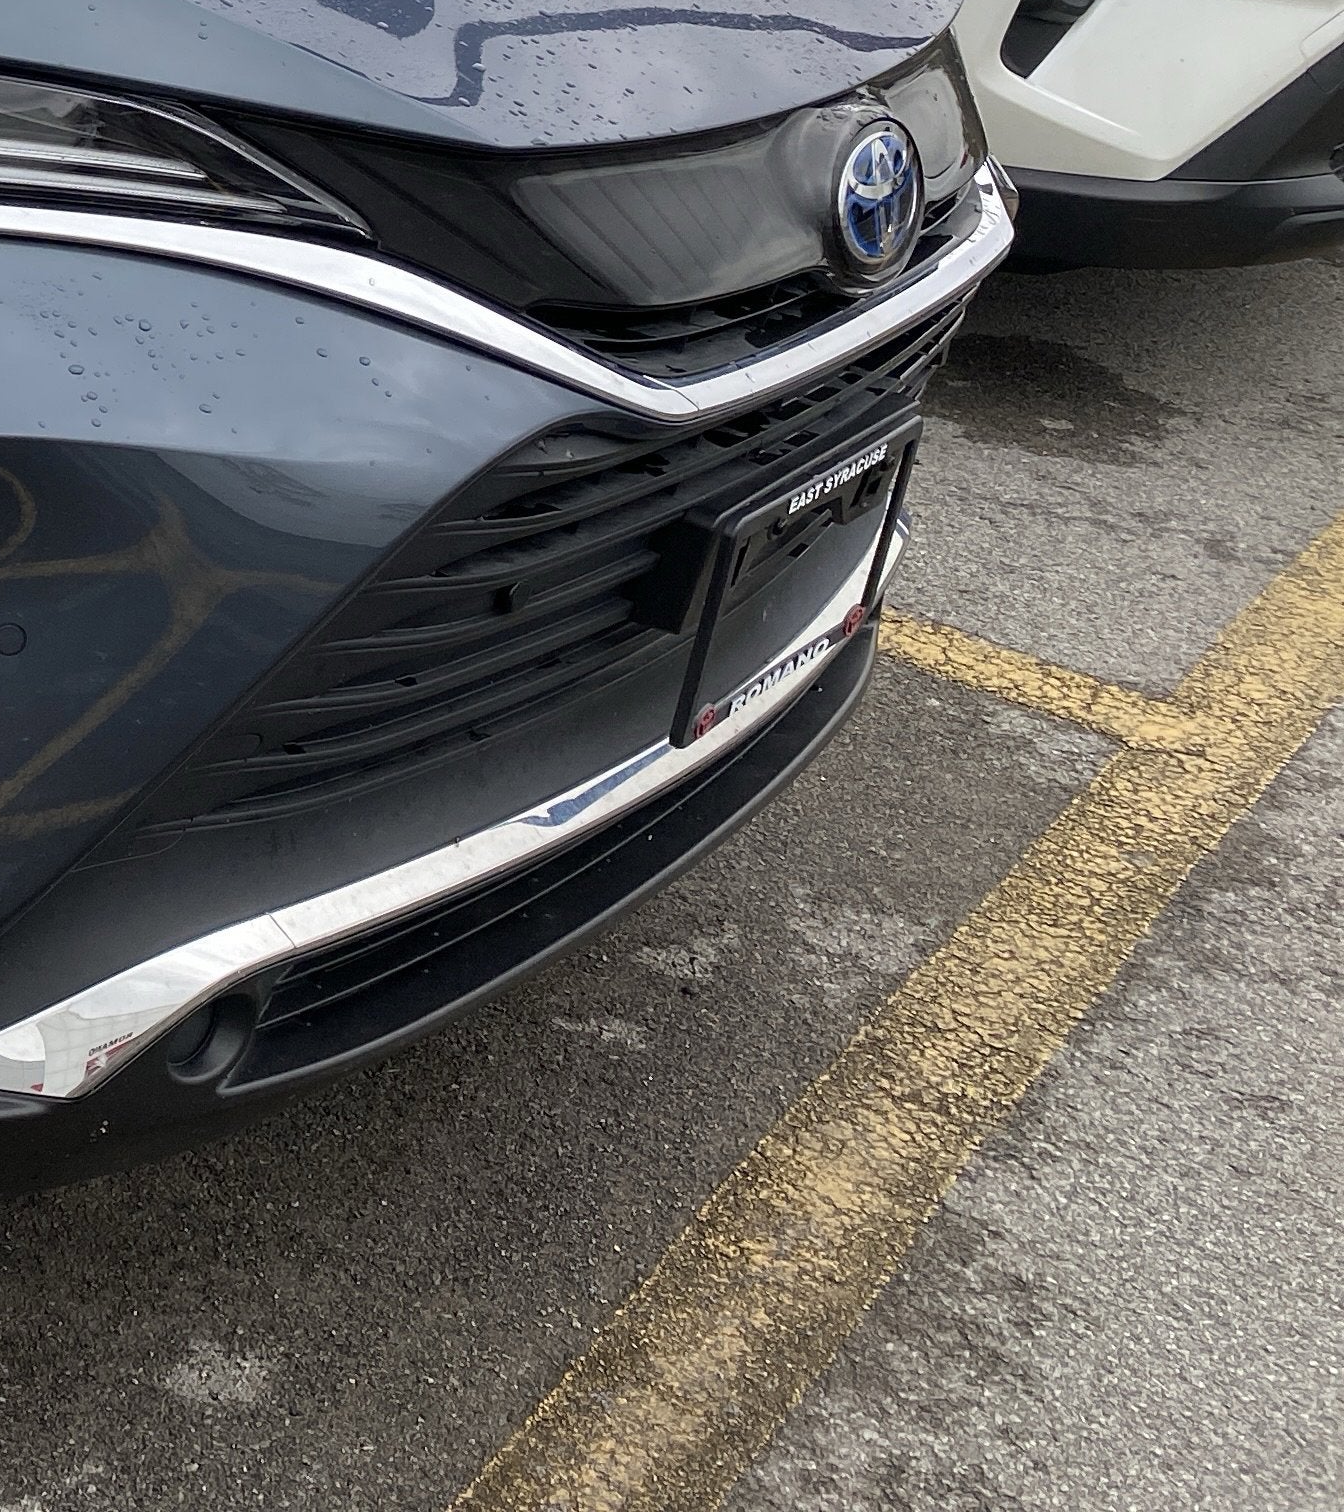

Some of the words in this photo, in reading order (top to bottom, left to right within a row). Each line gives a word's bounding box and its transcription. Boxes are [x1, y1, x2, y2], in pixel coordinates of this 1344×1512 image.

[788, 482, 824, 515] EAST
[823, 443, 888, 494] SYRACUSE
[729, 637, 830, 718] ROMANO
